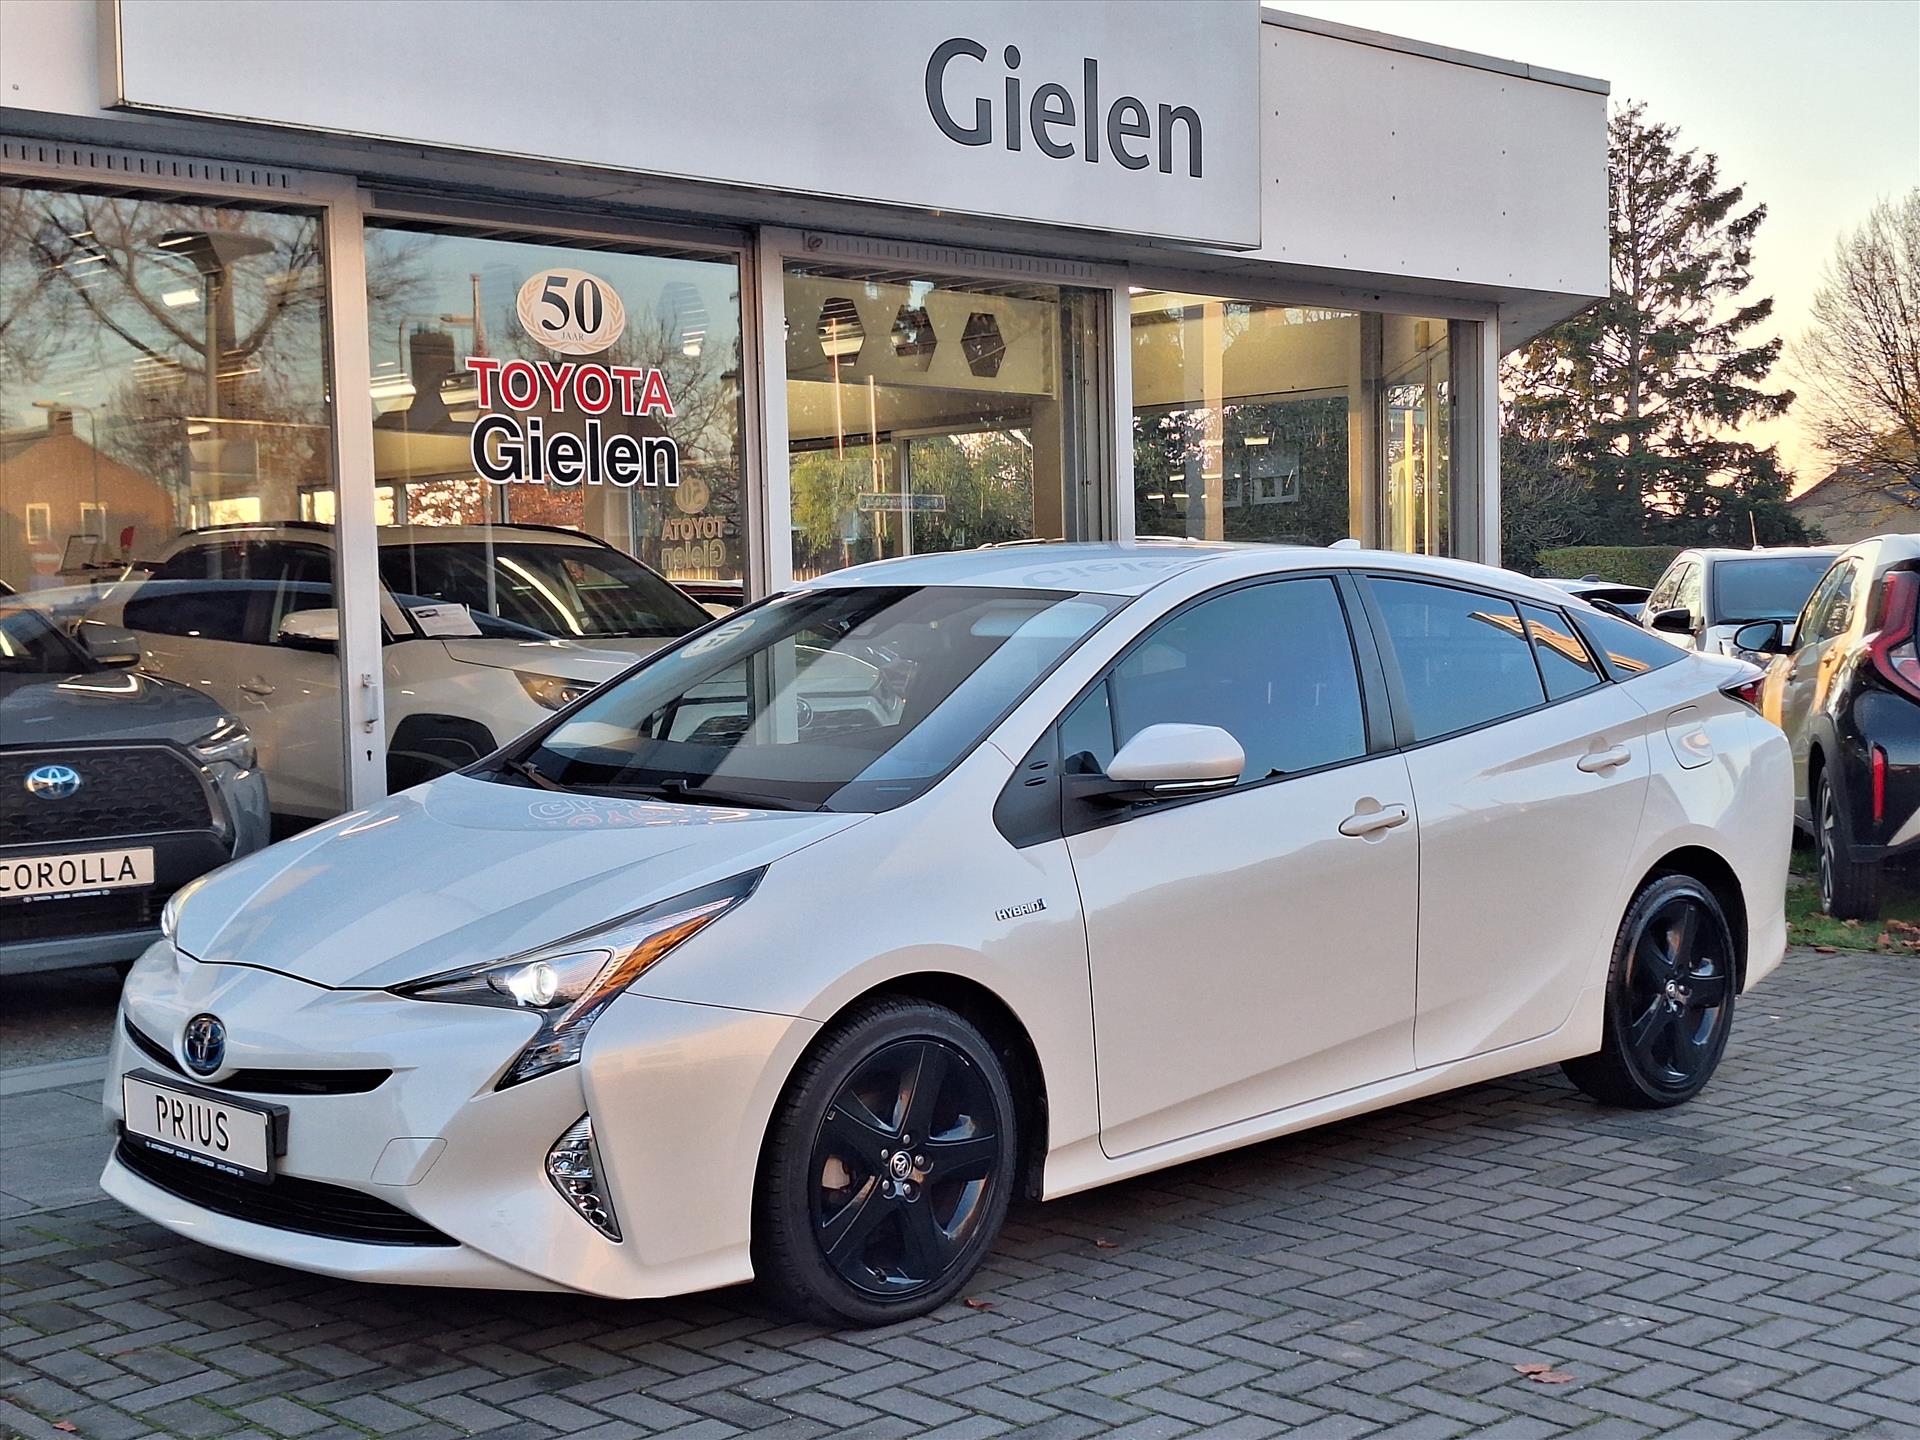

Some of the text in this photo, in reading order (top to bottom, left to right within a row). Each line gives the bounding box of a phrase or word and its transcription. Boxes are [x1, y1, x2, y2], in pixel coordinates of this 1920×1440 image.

[925, 38, 1203, 178] Gielen
[541, 276, 603, 334] 50
[561, 331, 584, 341] JAAR
[465, 357, 676, 418] TOYOTA
[471, 413, 680, 487] Gielen
[0, 855, 137, 892] COROLLA
[995, 901, 1041, 921] HYBRID
[155, 1094, 230, 1152] PRIUS
